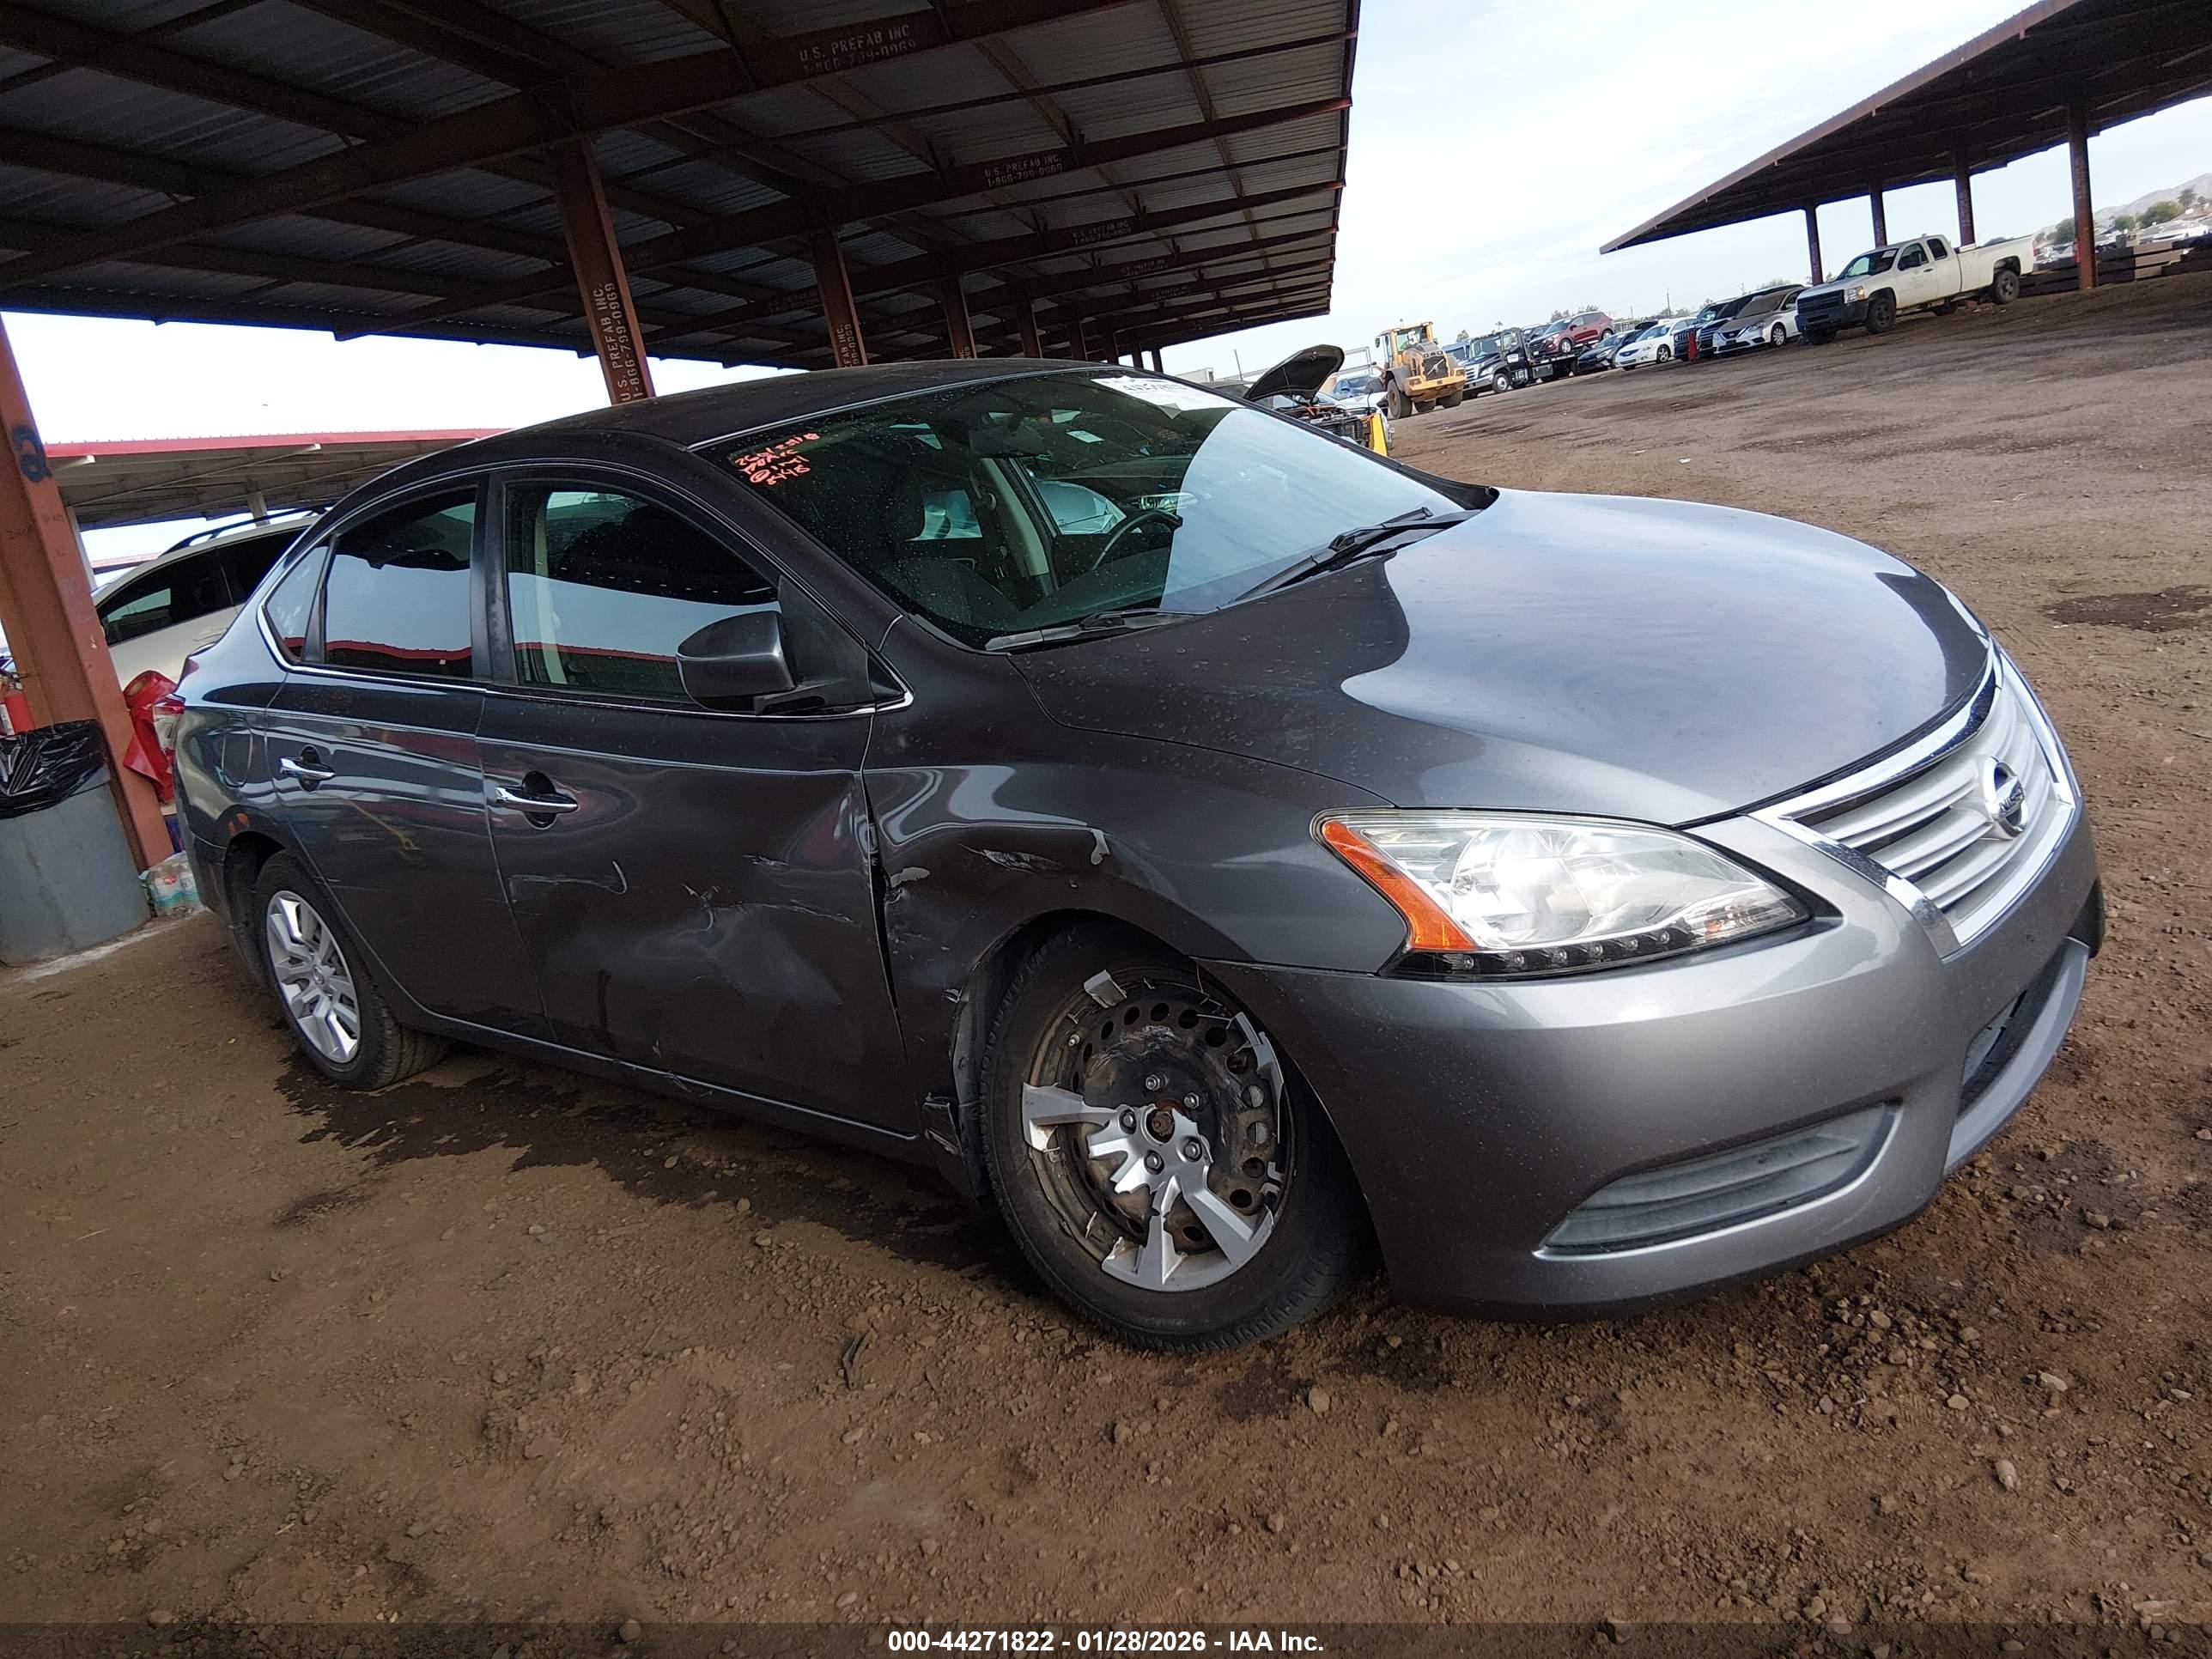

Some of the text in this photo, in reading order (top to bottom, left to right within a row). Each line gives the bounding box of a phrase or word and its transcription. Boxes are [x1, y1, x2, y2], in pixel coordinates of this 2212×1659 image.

[831, 31, 883, 56] PREFAB
[601, 317, 624, 369] PREFAB
[605, 283, 644, 398] 1-866-799-0969
[1408, 331, 1417, 345] 5
[618, 375, 631, 402] U.S.
